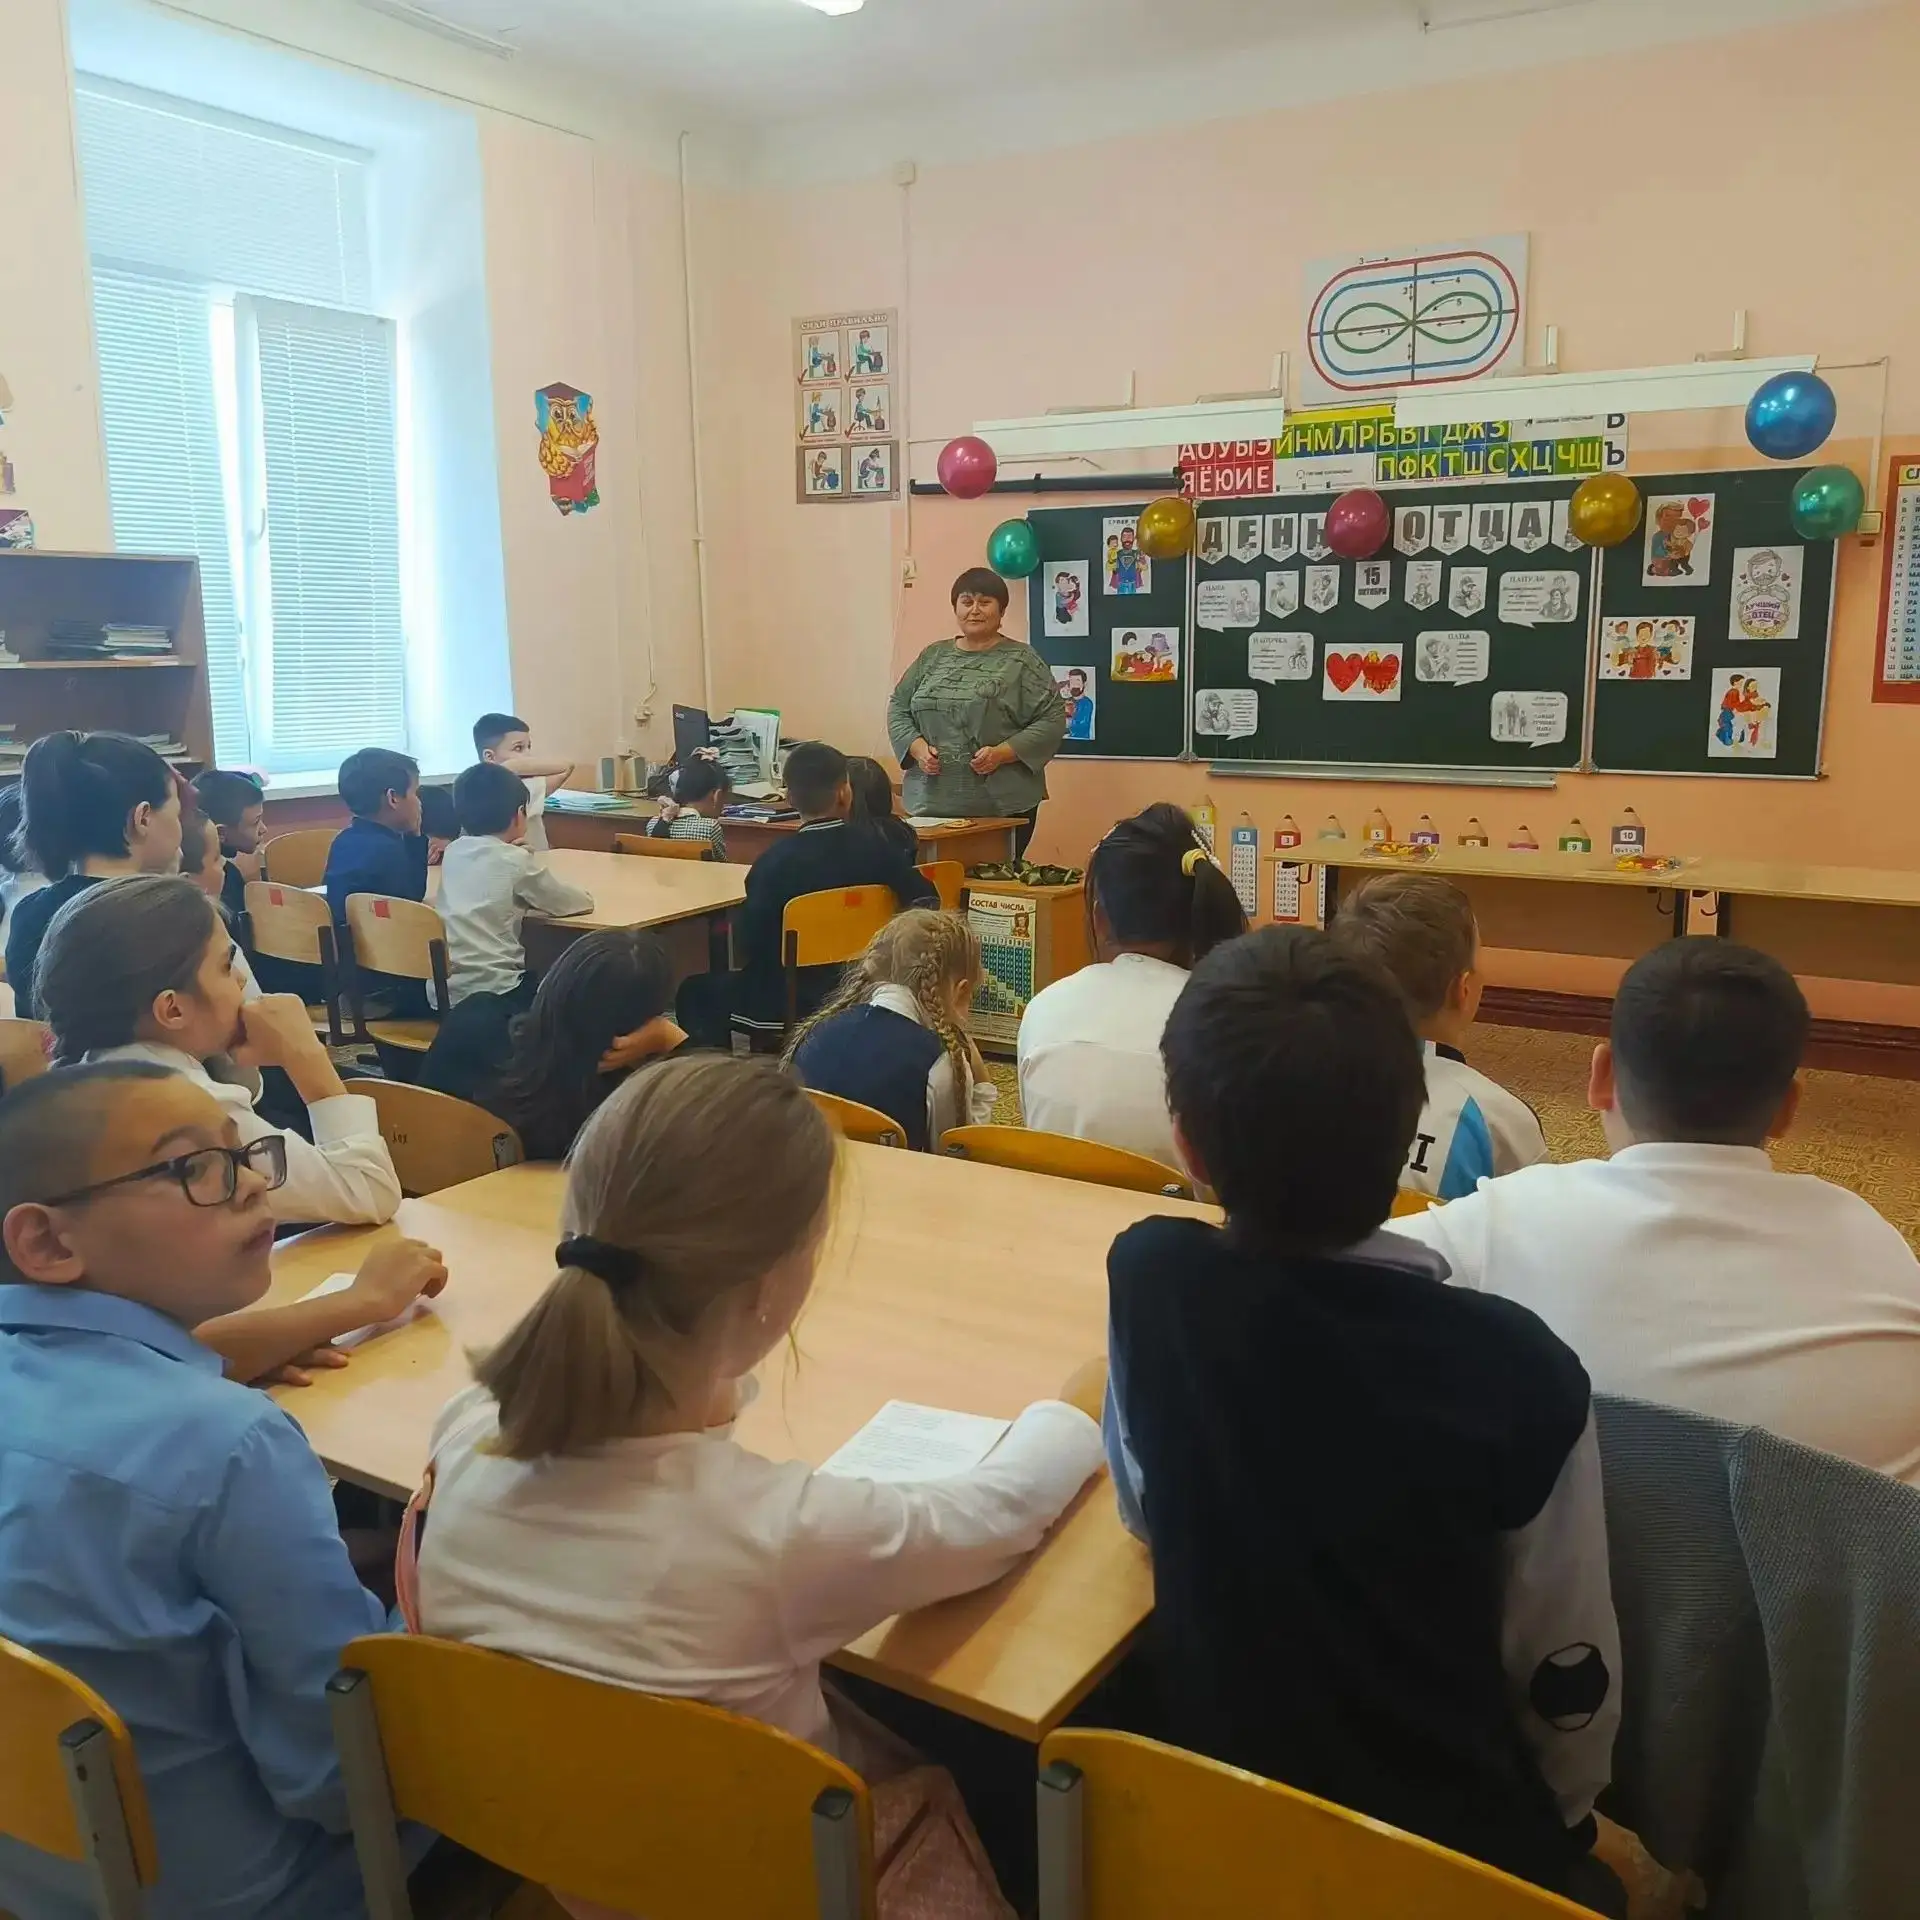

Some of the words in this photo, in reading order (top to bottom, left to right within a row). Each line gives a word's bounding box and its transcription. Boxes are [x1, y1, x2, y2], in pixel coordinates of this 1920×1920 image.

[1181, 466, 1270, 494] ЯЁЮИЕ
[1604, 441, 1625, 466] Ъ
[1363, 566, 1381, 586] 15
[1357, 587, 1388, 597] ОКТЯБРЯ
[1623, 832, 1634, 840] 10
[970, 899, 998, 909] СОСТАВ
[1000, 902, 1025, 911] ЧИСЛА
